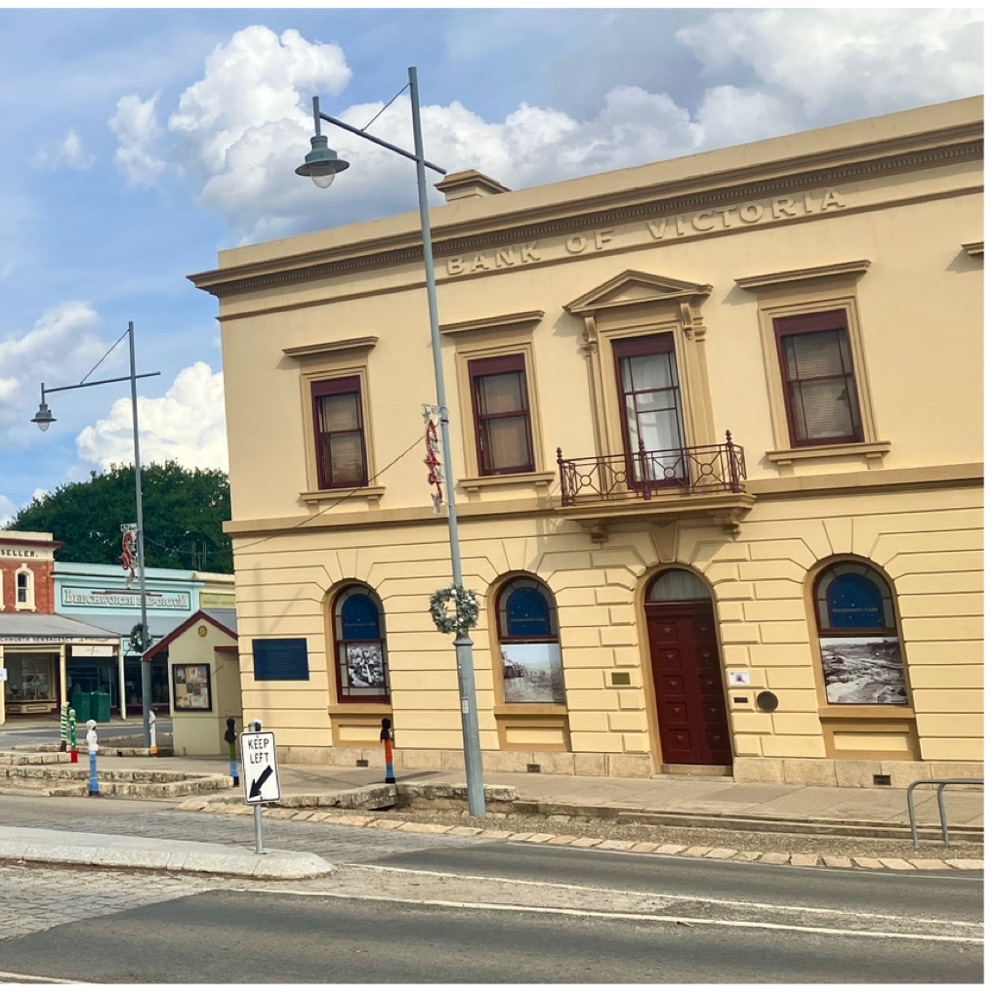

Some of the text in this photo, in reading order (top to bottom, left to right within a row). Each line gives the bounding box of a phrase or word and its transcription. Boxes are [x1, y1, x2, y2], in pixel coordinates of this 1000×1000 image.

[446, 187, 847, 277] BANK OF VICTORIA
[247, 738, 270, 750] KEEP
[249, 752, 270, 764] LEFT
